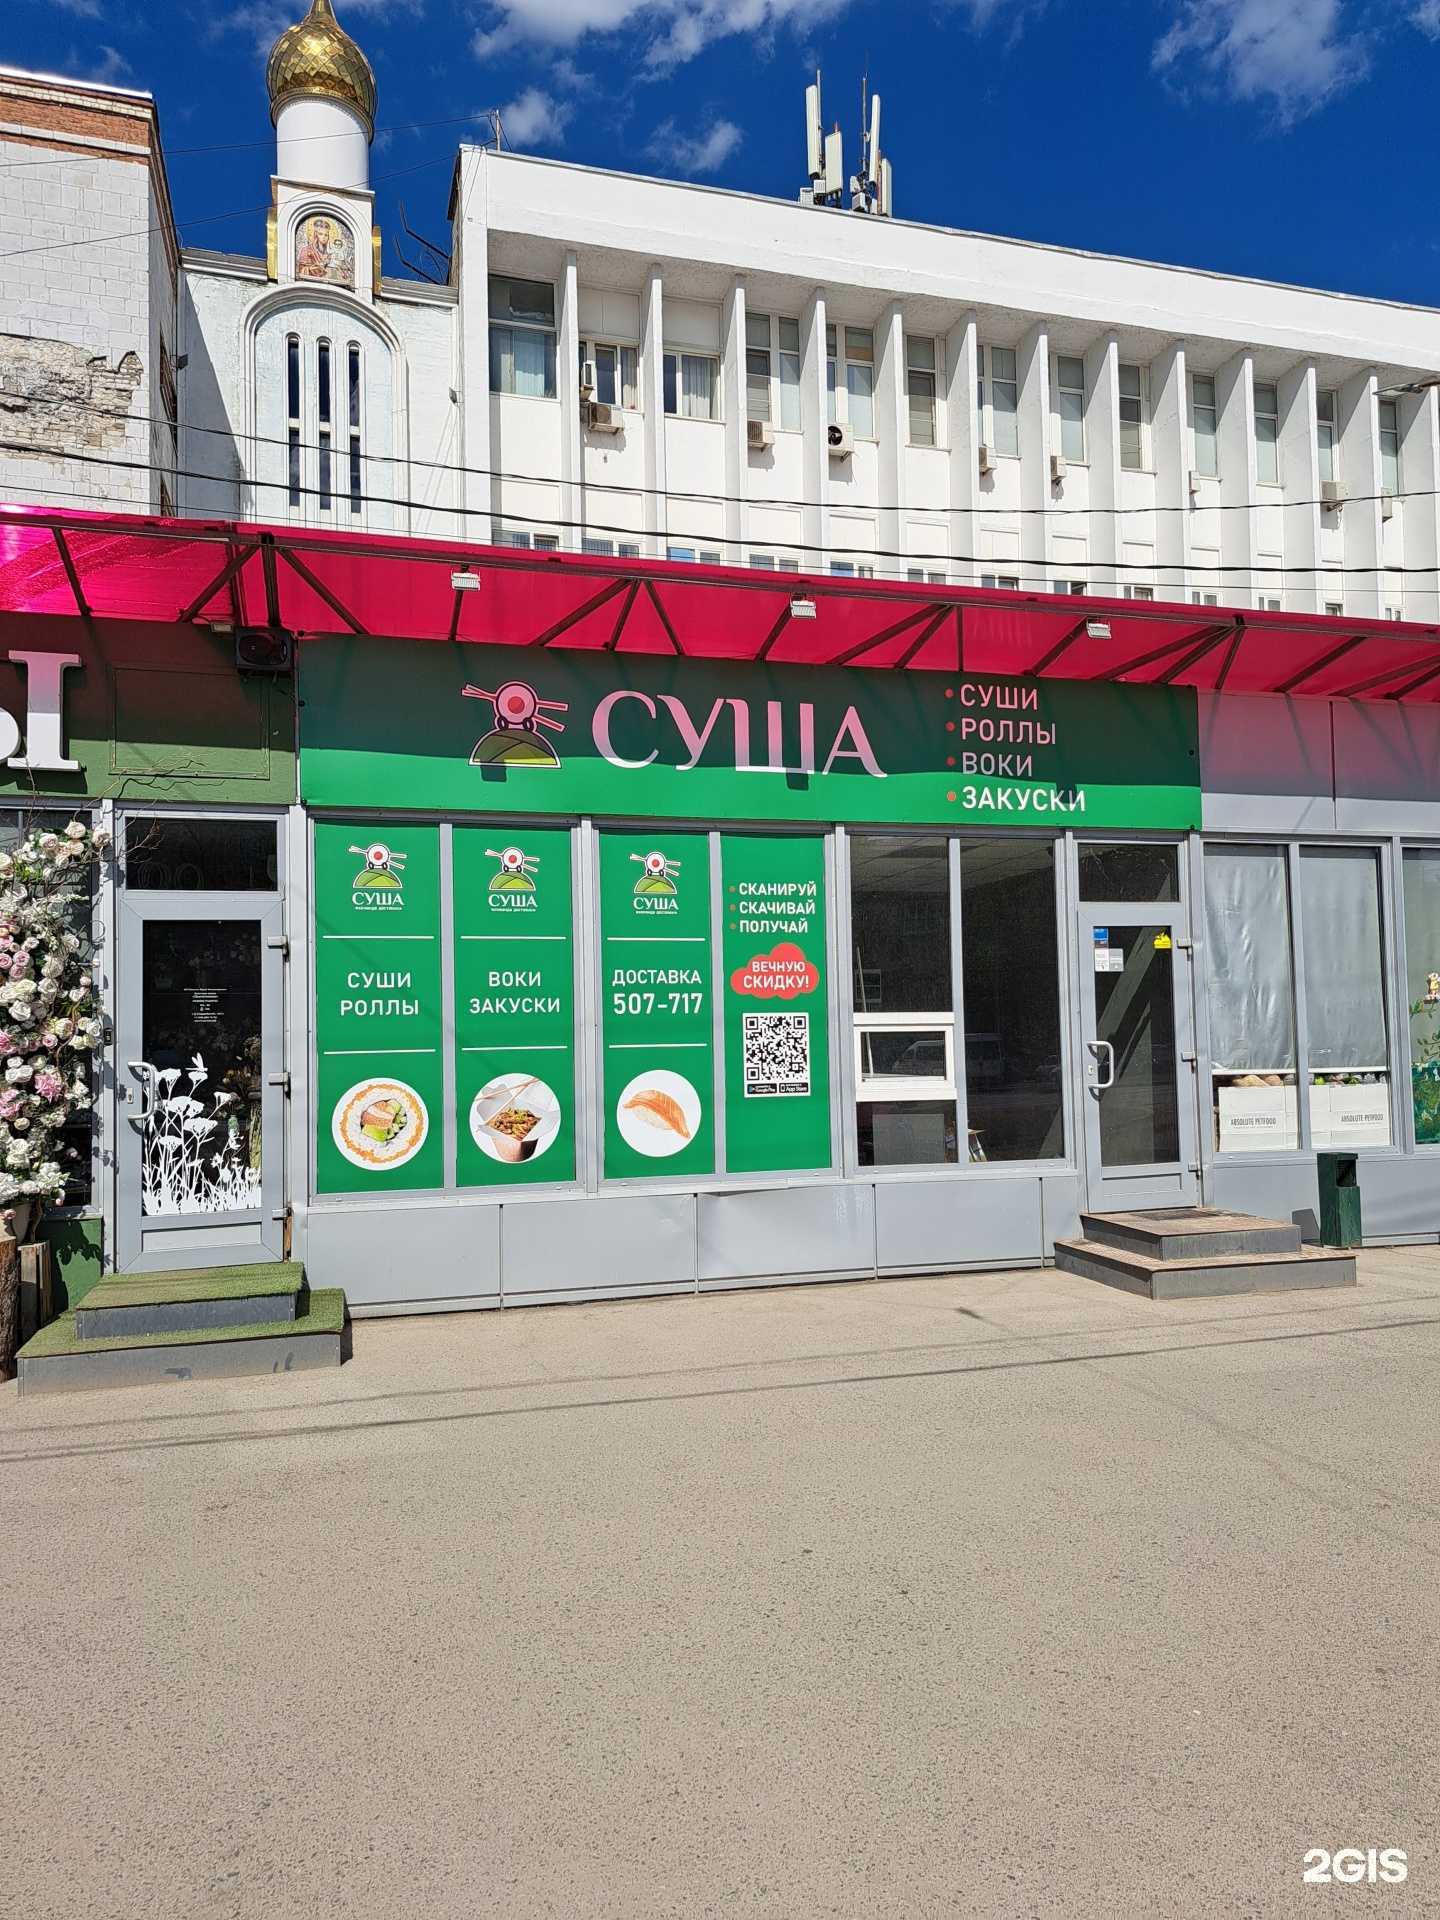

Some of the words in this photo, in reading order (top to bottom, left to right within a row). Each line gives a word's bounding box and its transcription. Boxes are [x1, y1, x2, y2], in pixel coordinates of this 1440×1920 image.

[960, 684, 1038, 710] СУШИ
[591, 690, 888, 778] СУША
[961, 718, 1056, 745] РОЛЛЫ
[962, 752, 1033, 777] ВОКИ
[962, 785, 1086, 812] ЗАКУСКИ
[738, 880, 817, 896] СКАНИРУЙ
[352, 892, 405, 906] СУША
[488, 894, 538, 908] СУША
[633, 896, 679, 910] СУША
[739, 899, 816, 915] СКАЧИВАЙ
[739, 917, 808, 933] ПОЛУЧАЙ
[752, 961, 806, 973] ВЕЧНУЮ
[347, 972, 411, 989] СУШИ
[488, 971, 541, 987] ВОКИ
[612, 969, 702, 987] ДОСТАВКА
[743, 975, 809, 990] СКИДКУ!
[340, 999, 419, 1016] РОЛЛЫ
[469, 997, 560, 1014] ЗАКУСКИ
[613, 992, 703, 1015] 507-717
